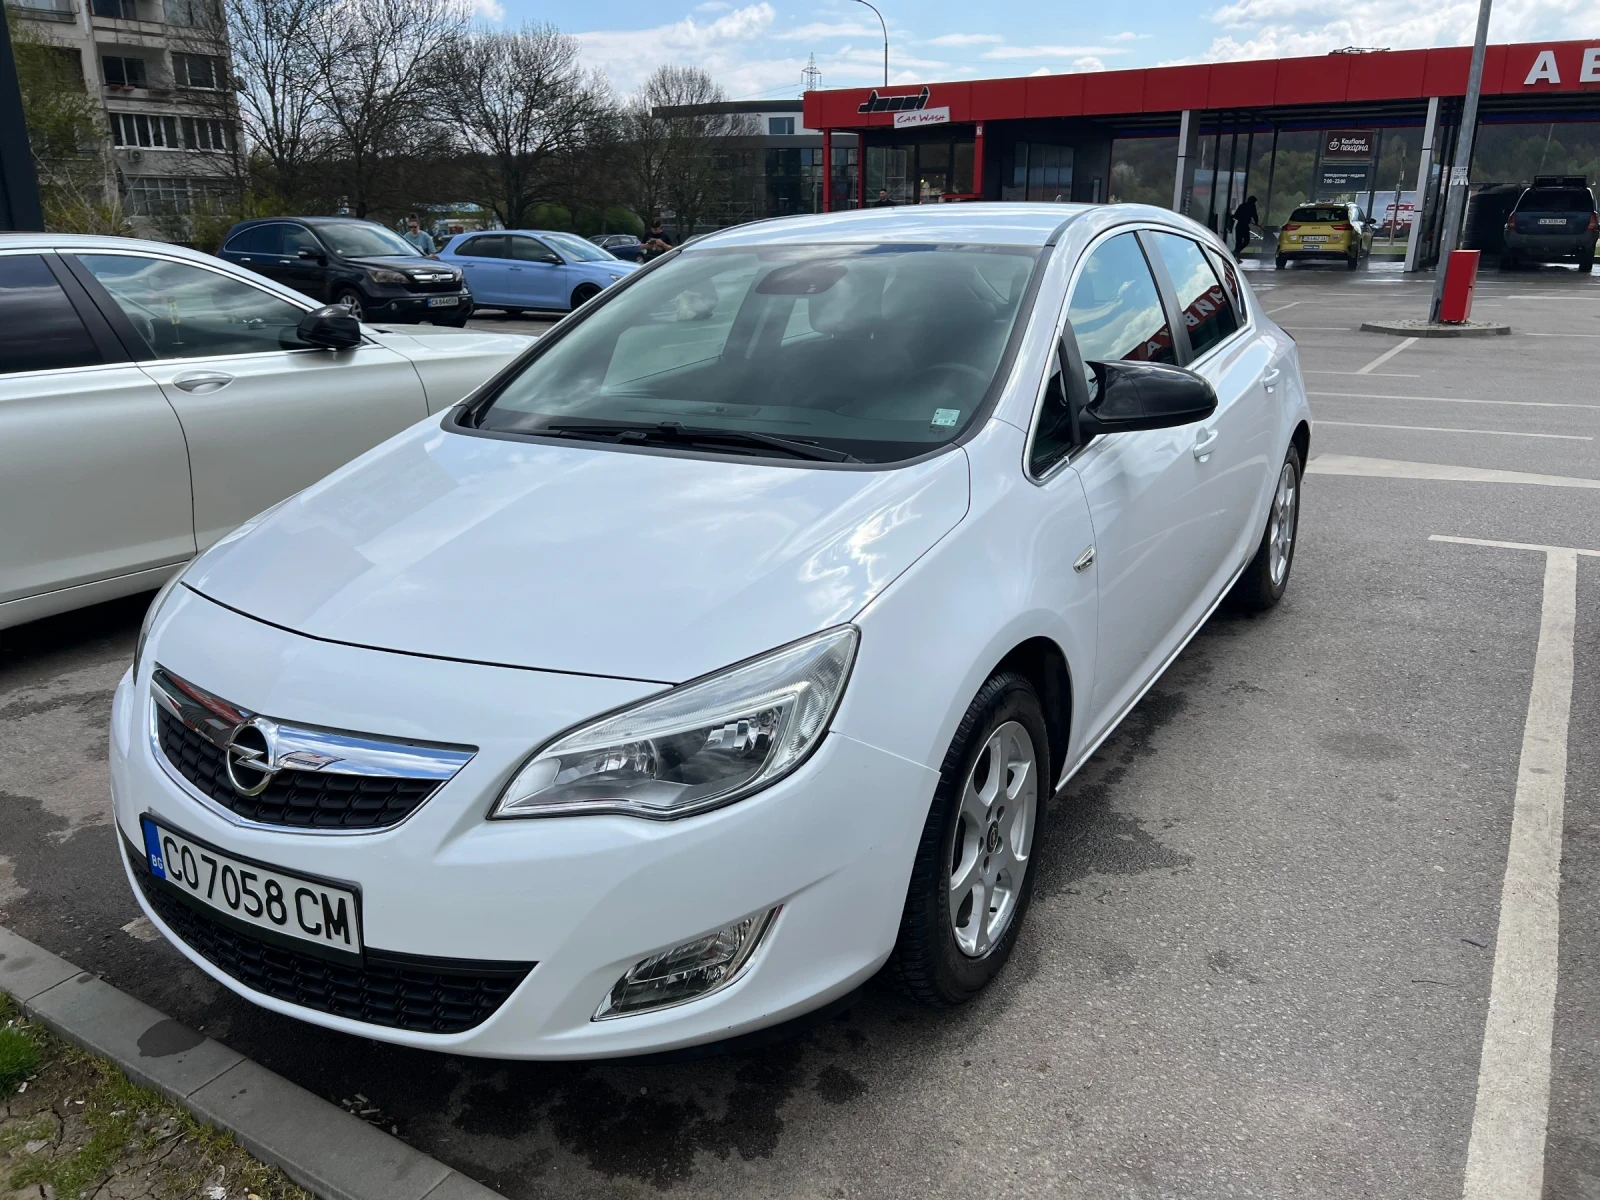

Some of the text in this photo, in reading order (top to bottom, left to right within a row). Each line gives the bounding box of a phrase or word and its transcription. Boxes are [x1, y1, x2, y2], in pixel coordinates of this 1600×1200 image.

[896, 114, 946, 124] CAR WASH
[151, 836, 351, 945] BG CO 7058 CM
